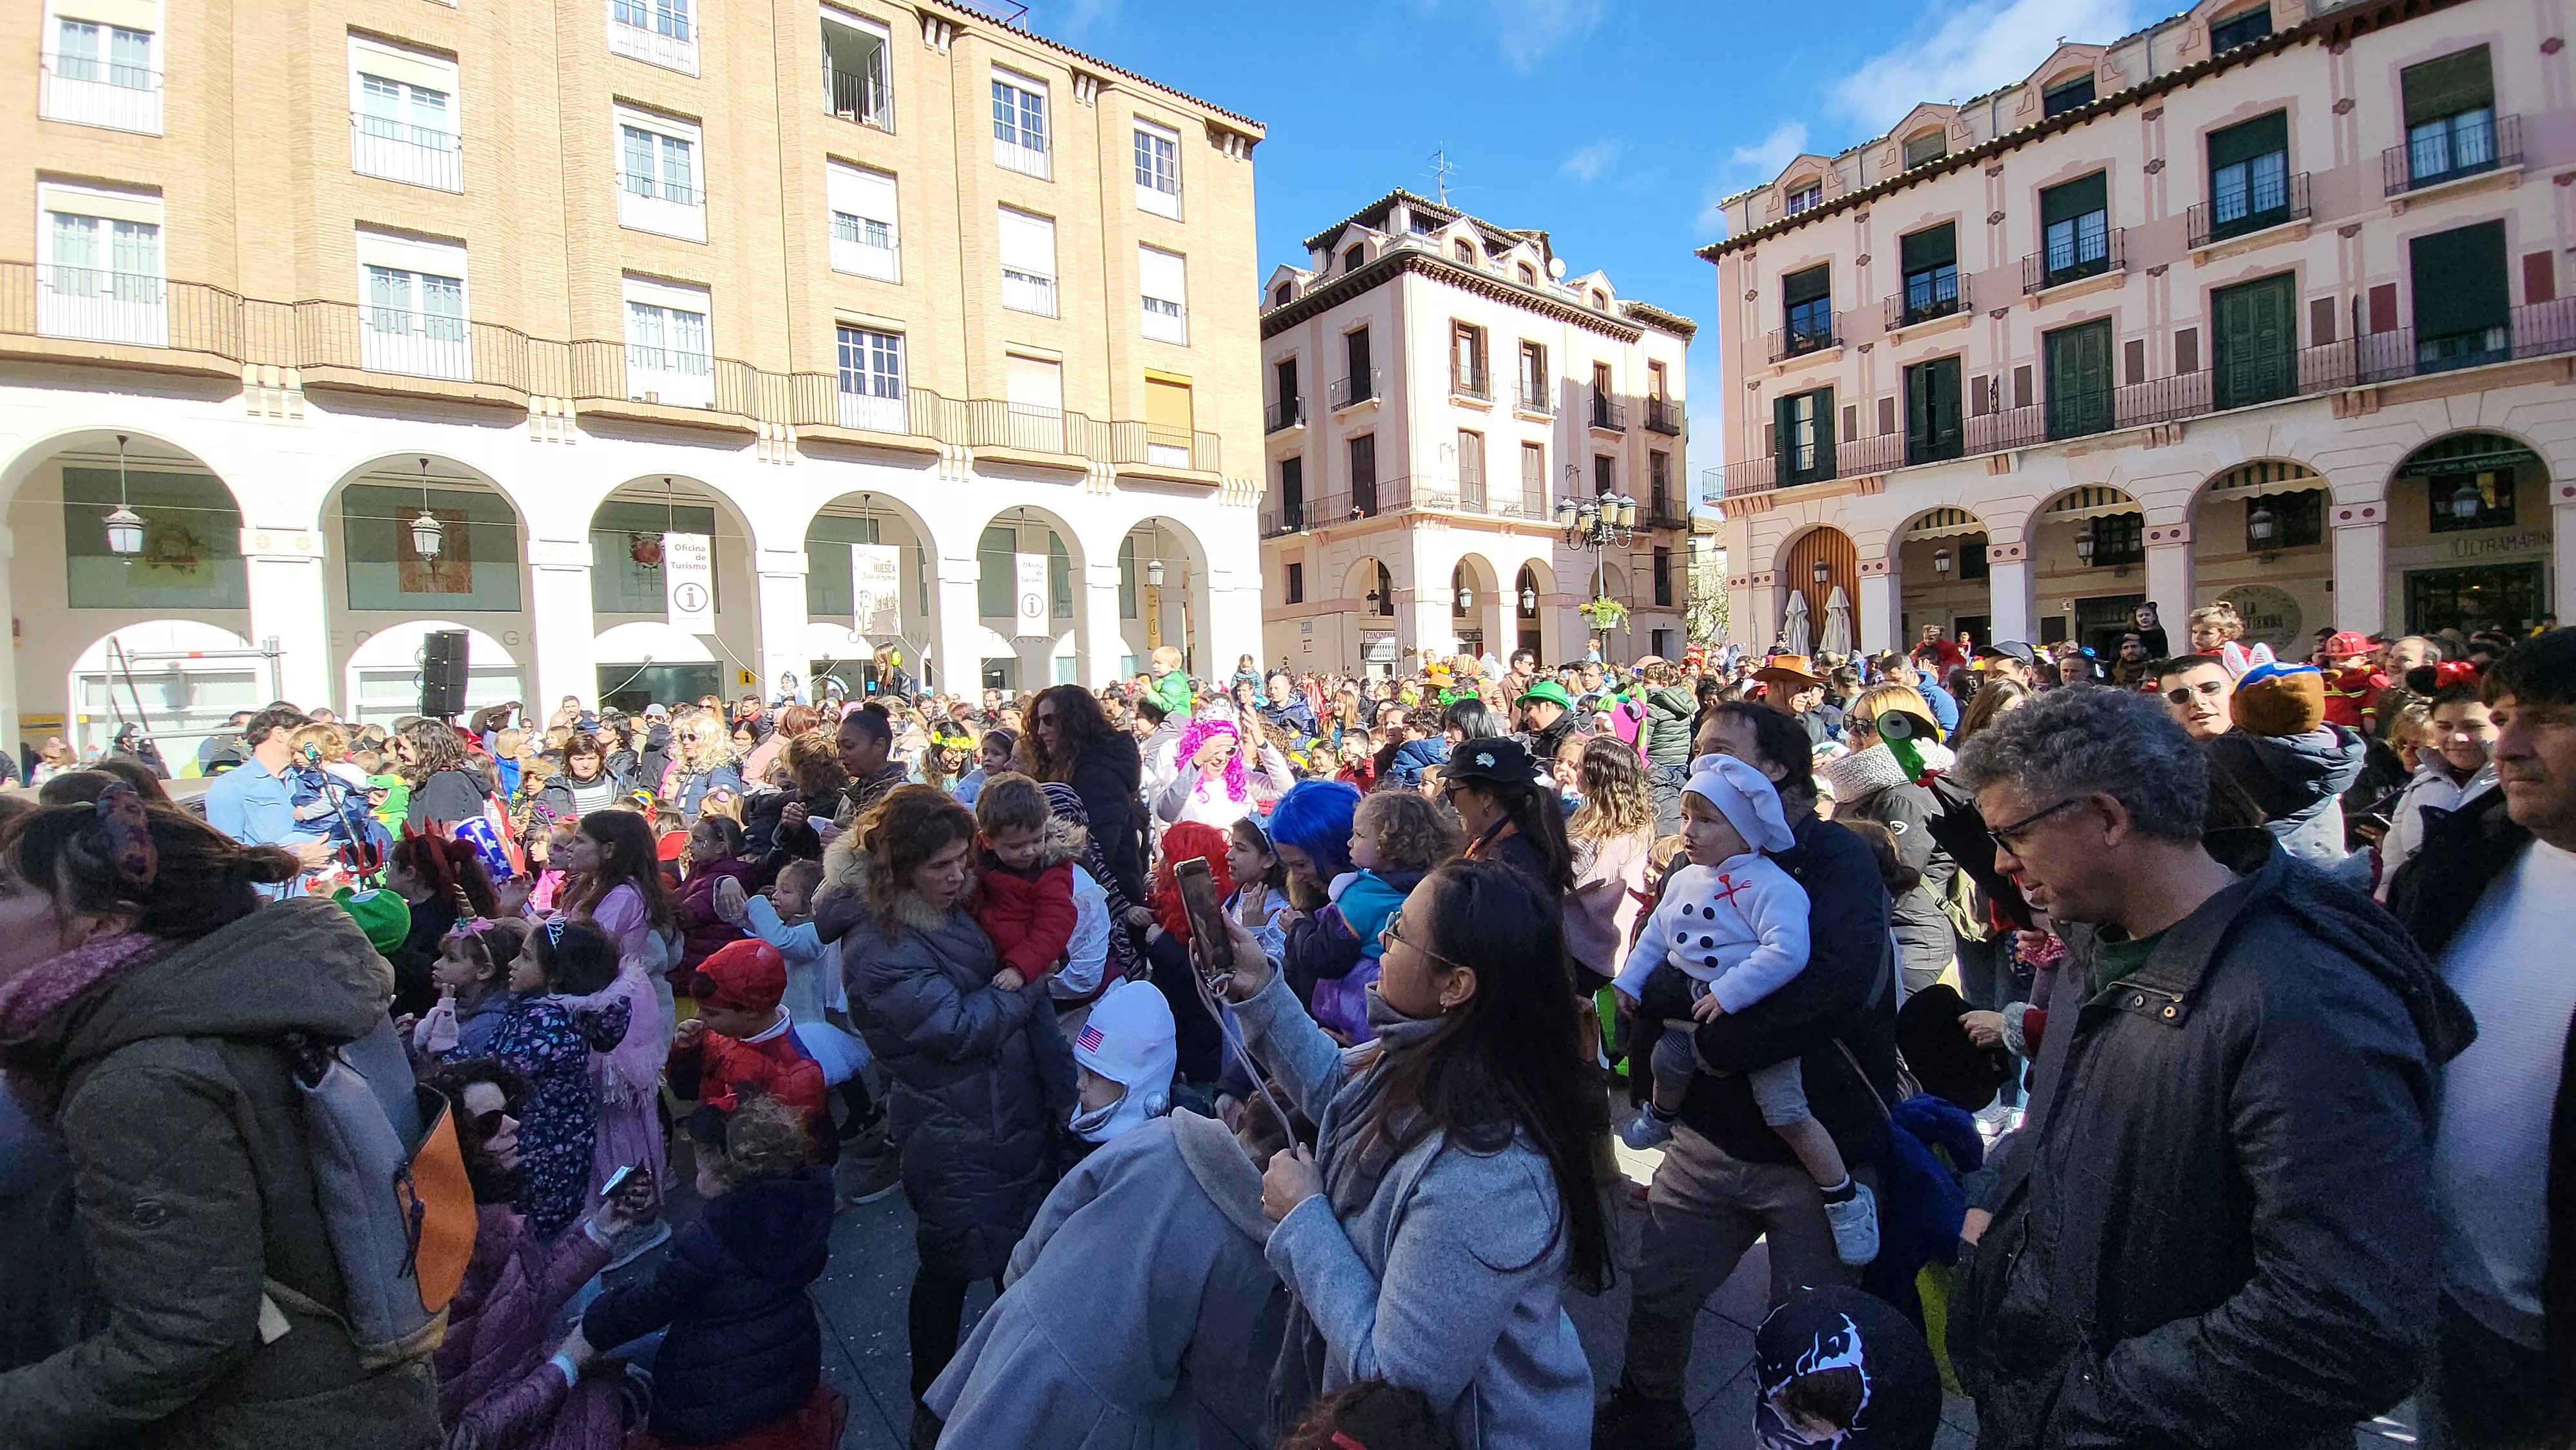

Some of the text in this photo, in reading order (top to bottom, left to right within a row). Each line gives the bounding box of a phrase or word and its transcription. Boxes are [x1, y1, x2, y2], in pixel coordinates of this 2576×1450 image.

[674, 543, 706, 552] Oficina
[2455, 530, 2553, 558] ULTRAMARIN
[670, 561, 707, 570] Turismo
[874, 563, 896, 573] HUESCA
